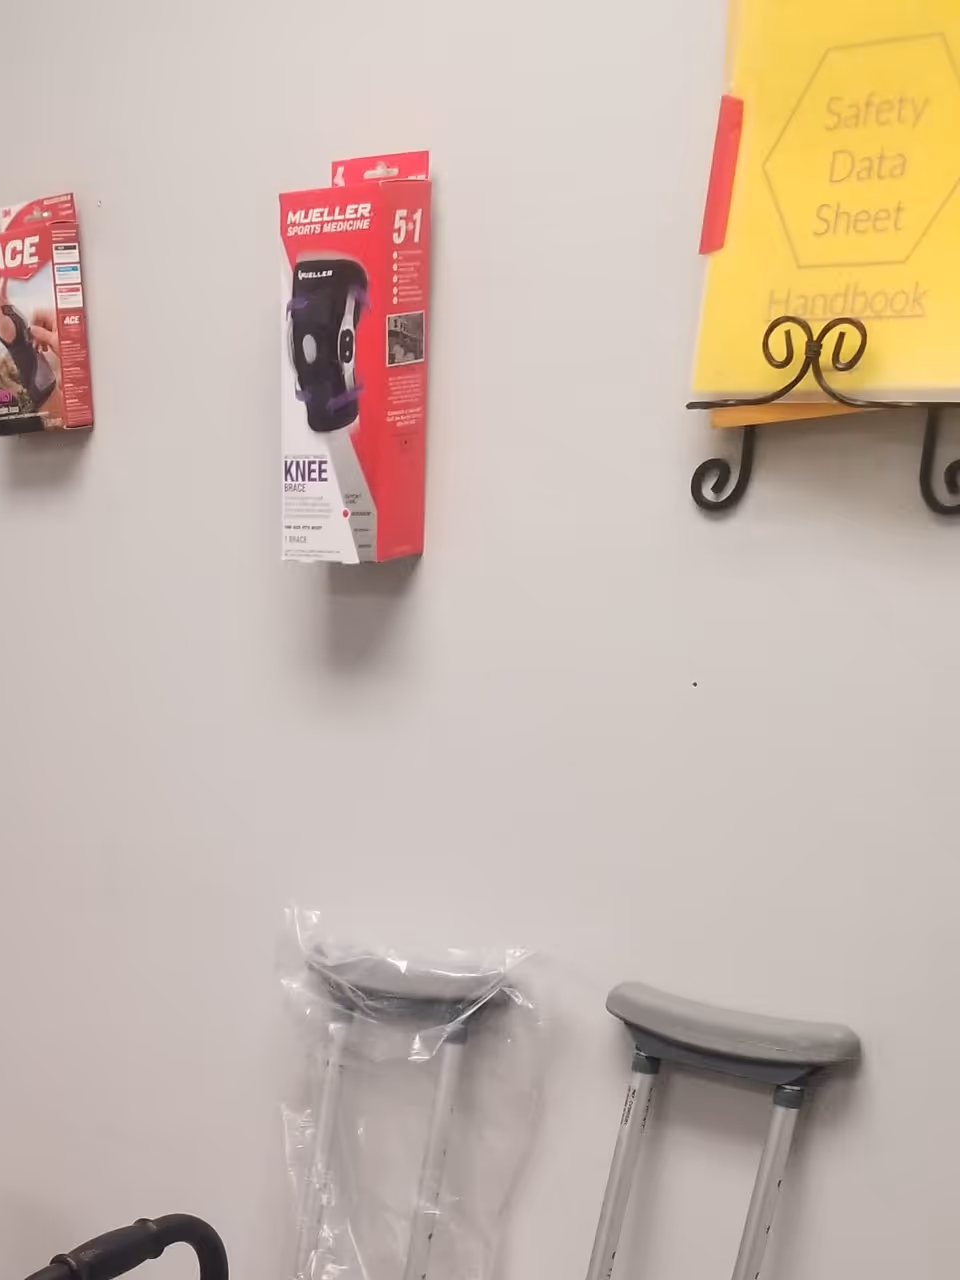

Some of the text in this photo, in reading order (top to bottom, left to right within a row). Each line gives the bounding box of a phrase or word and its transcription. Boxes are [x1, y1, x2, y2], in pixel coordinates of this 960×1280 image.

[824, 92, 929, 132] Safety
[829, 148, 907, 183] Data
[286, 203, 372, 225] MUELLER
[812, 201, 907, 236] Sheet
[286, 218, 371, 237] SPORTS MEDICINE
[767, 281, 929, 318] Handbook
[63, 315, 81, 325] ACE
[284, 460, 329, 482] KNEE
[284, 482, 307, 493] BRACE
